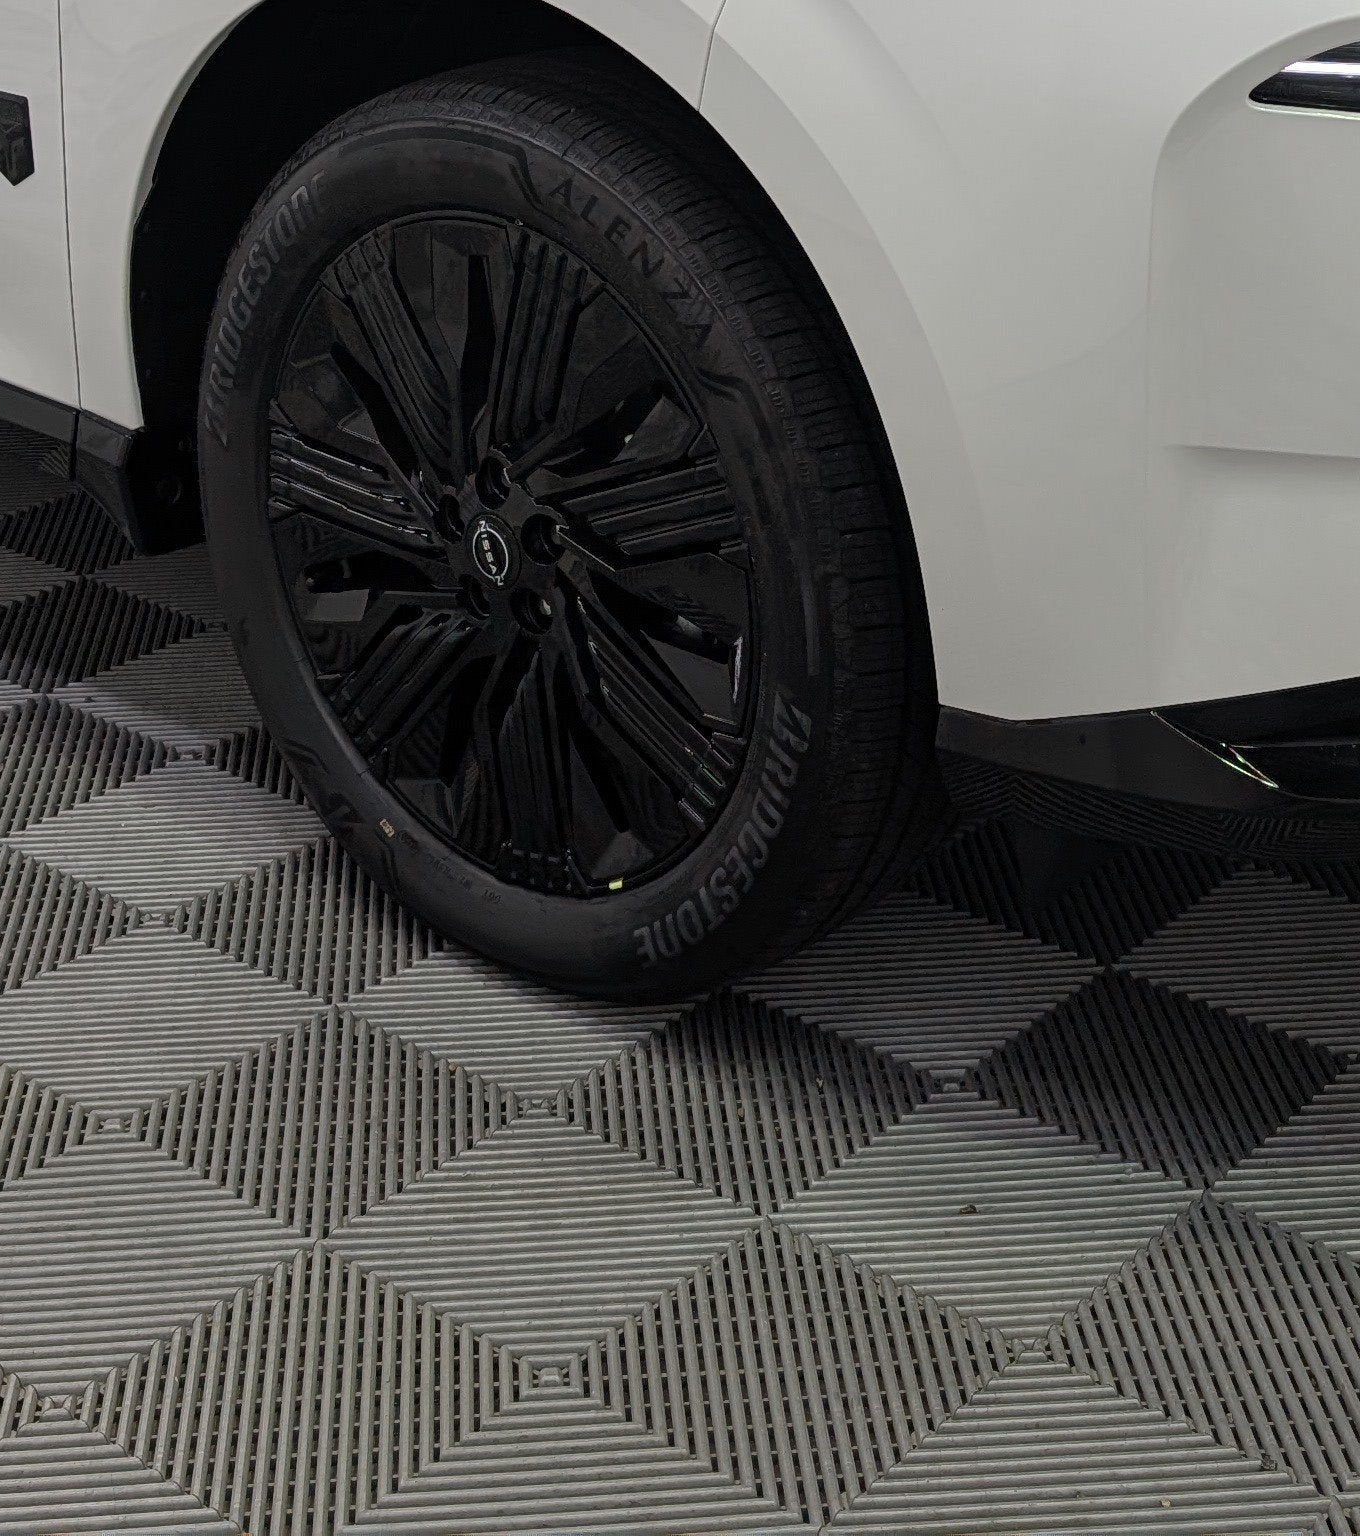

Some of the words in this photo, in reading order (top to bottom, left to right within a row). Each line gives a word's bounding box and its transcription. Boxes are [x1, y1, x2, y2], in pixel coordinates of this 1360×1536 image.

[205, 167, 327, 448] BRIDGESTONE
[548, 177, 714, 350] ALENZA
[632, 691, 813, 969] BRIDGESTONE
